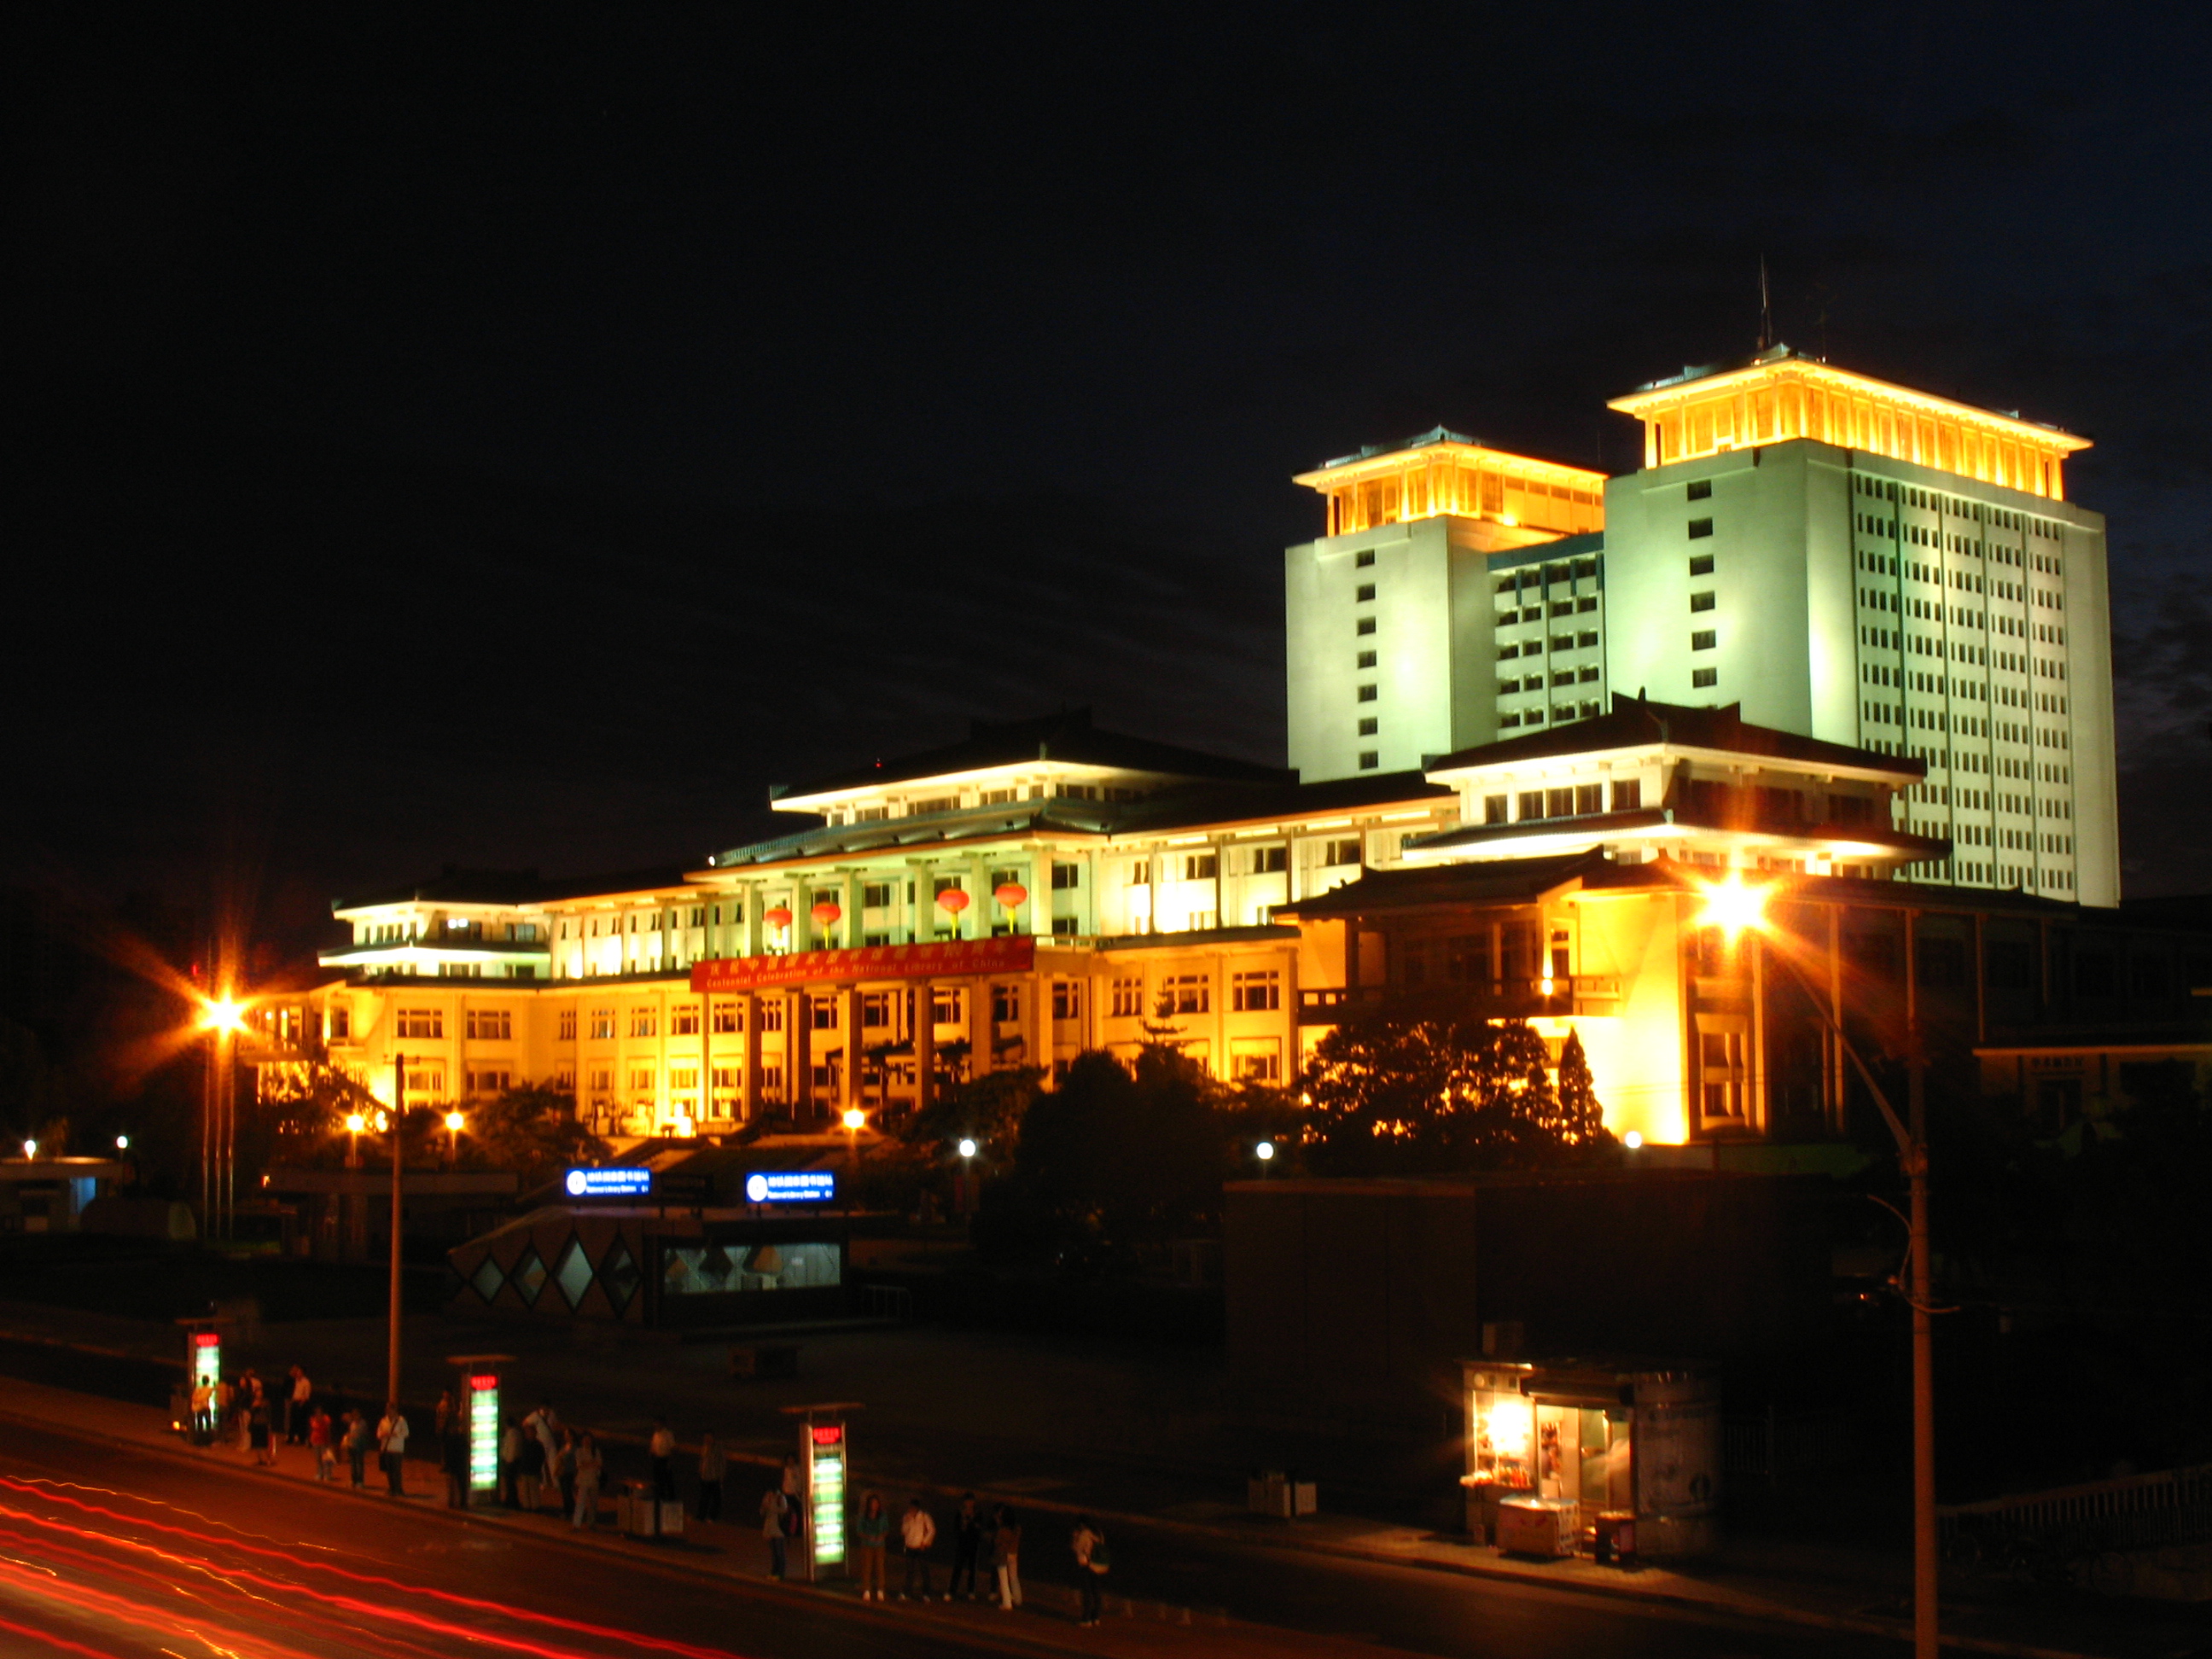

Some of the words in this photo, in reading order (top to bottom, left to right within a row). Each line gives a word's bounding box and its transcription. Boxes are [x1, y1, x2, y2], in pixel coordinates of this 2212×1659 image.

[707, 975, 751, 988] Centennial
[757, 969, 807, 983] Celebration
[812, 966, 824, 975] of
[830, 965, 845, 975] the
[852, 963, 897, 974] National
[905, 961, 943, 972] Library
[952, 959, 963, 969] of
[973, 958, 1005, 969] China
